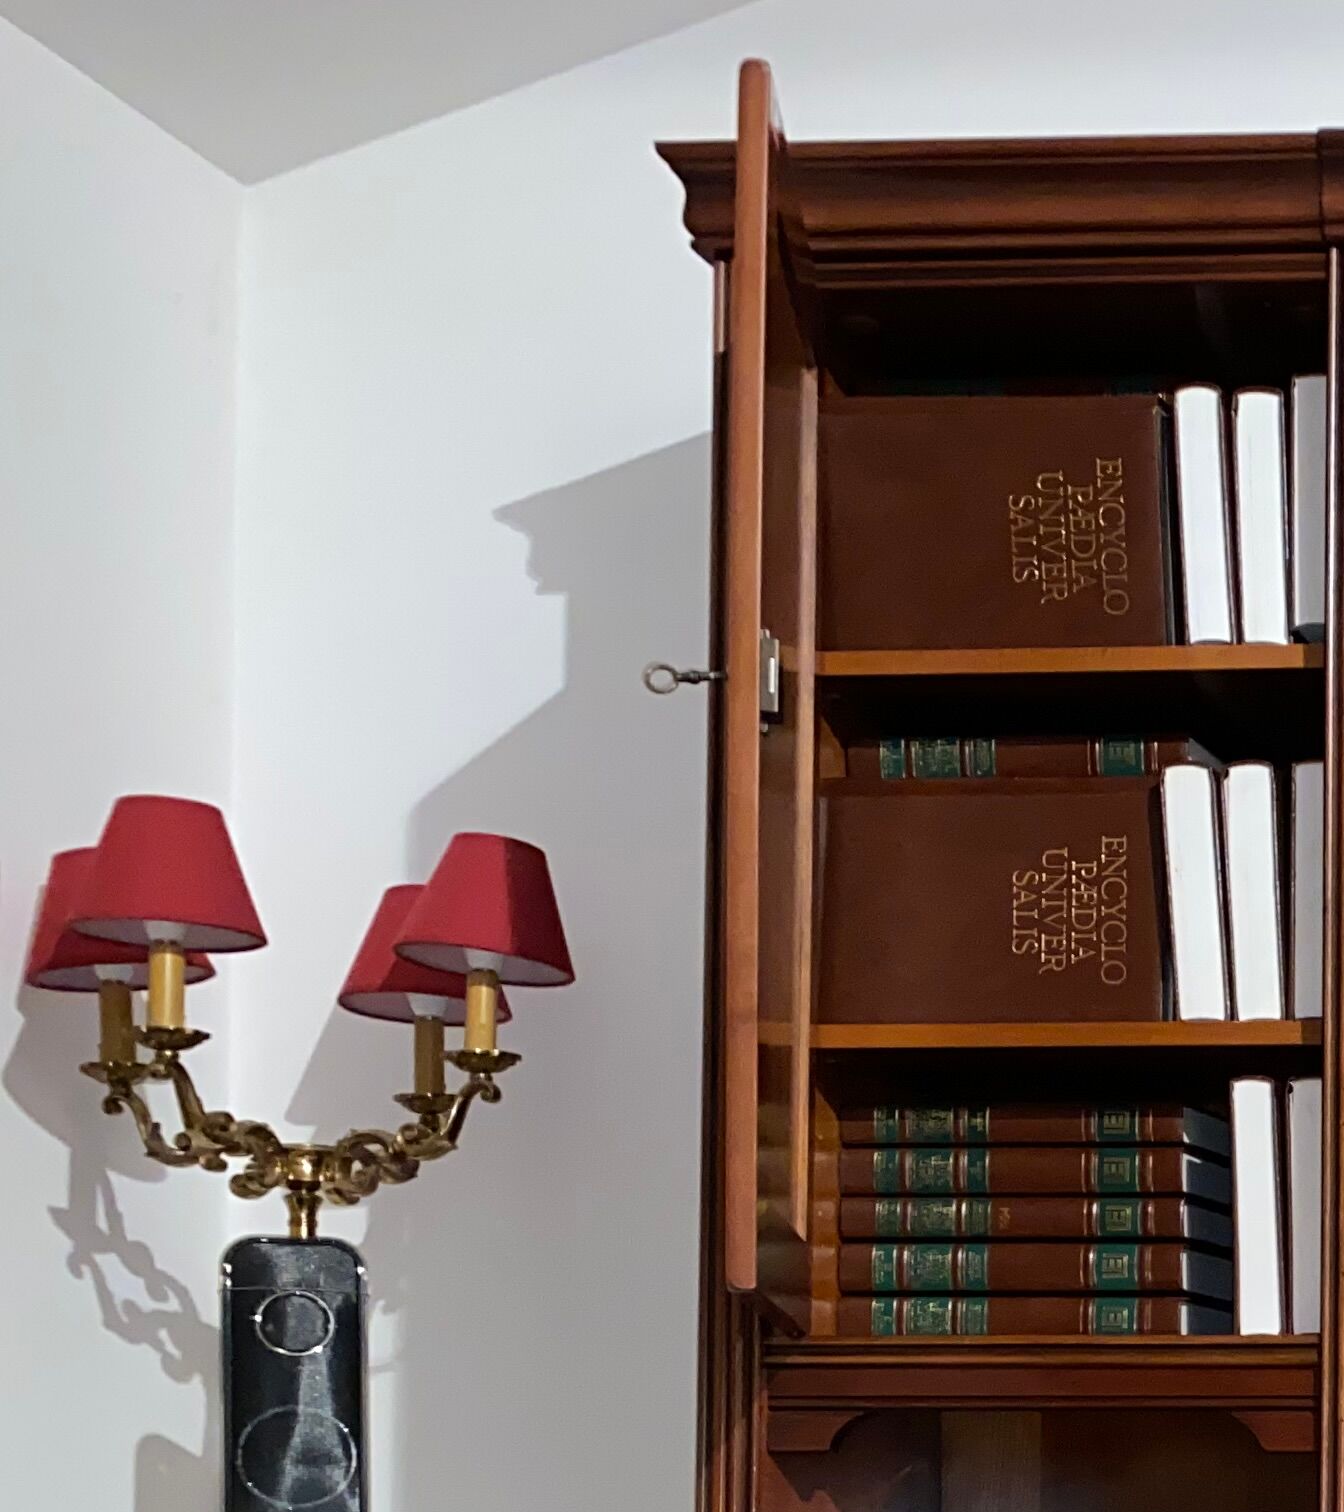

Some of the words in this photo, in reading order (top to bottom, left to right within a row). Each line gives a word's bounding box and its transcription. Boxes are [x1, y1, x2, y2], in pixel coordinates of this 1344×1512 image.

[1009, 495, 1039, 584] SALIS
[1036, 470, 1067, 604] UNIVER
[1067, 485, 1097, 594] PÆDIA
[1095, 458, 1130, 616] ENCYCLO
[1011, 871, 1038, 956] SALIS
[1040, 847, 1068, 975] UNIVER
[1071, 860, 1097, 964] PÆDIA
[1101, 836, 1128, 985] ENCYCLO
